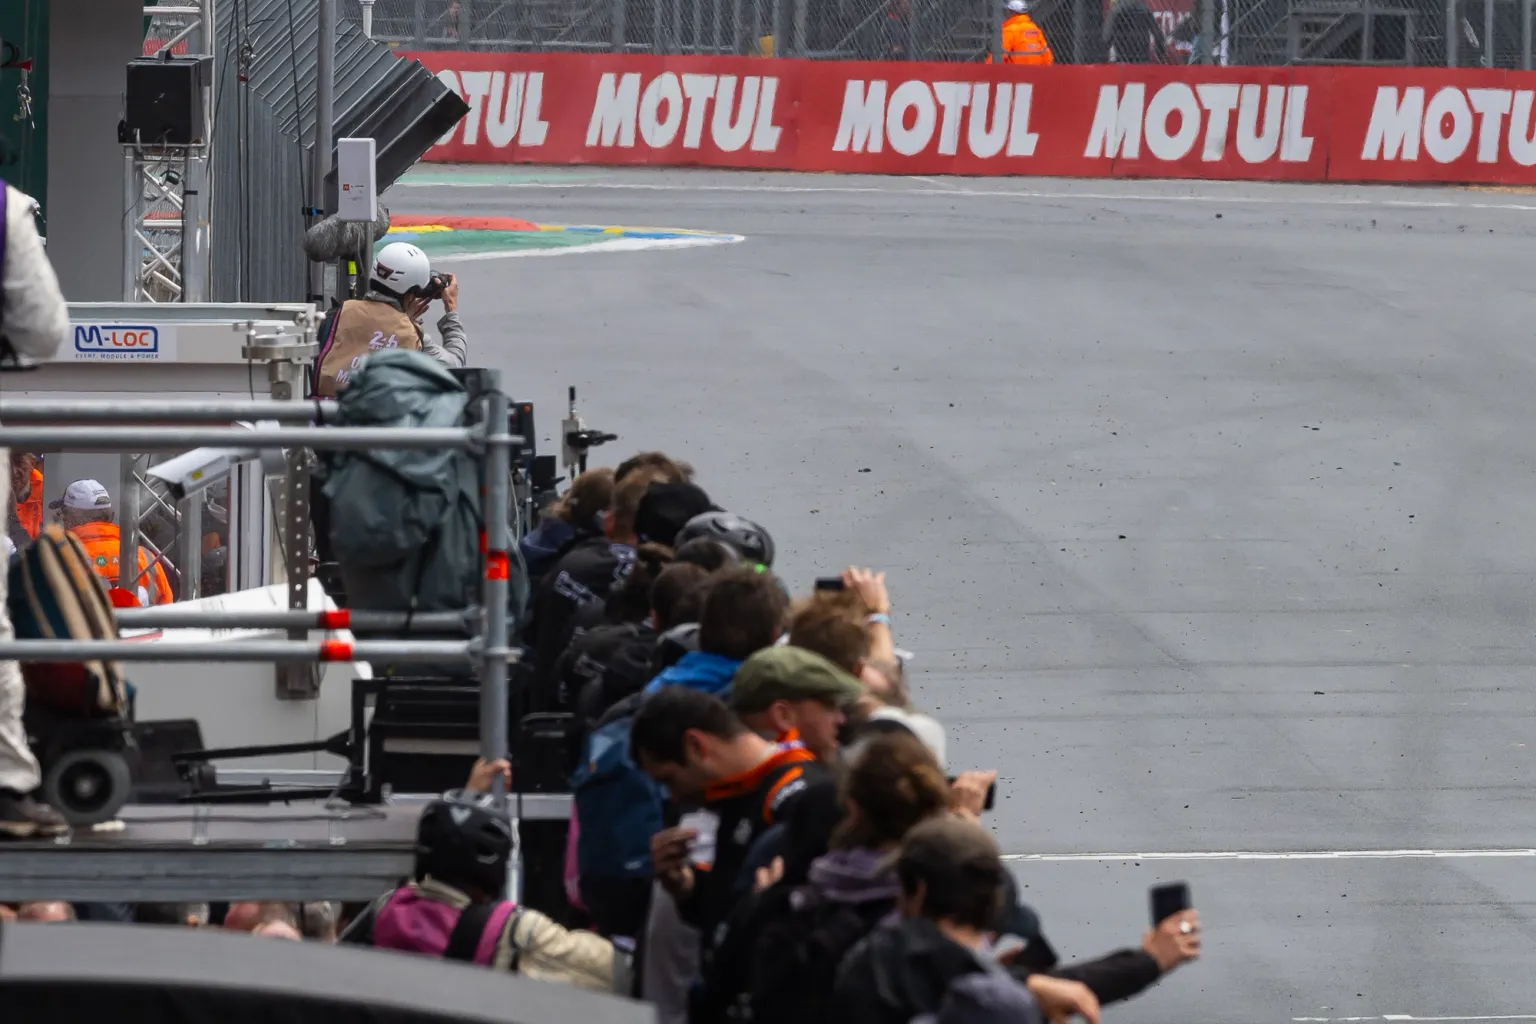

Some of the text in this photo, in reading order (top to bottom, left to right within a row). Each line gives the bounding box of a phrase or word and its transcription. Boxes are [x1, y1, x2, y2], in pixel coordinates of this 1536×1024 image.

[433, 69, 549, 149] OTUL
[586, 72, 783, 152] MOTUL
[833, 79, 1040, 158] MOTUL
[1084, 82, 1314, 164] MOTUL
